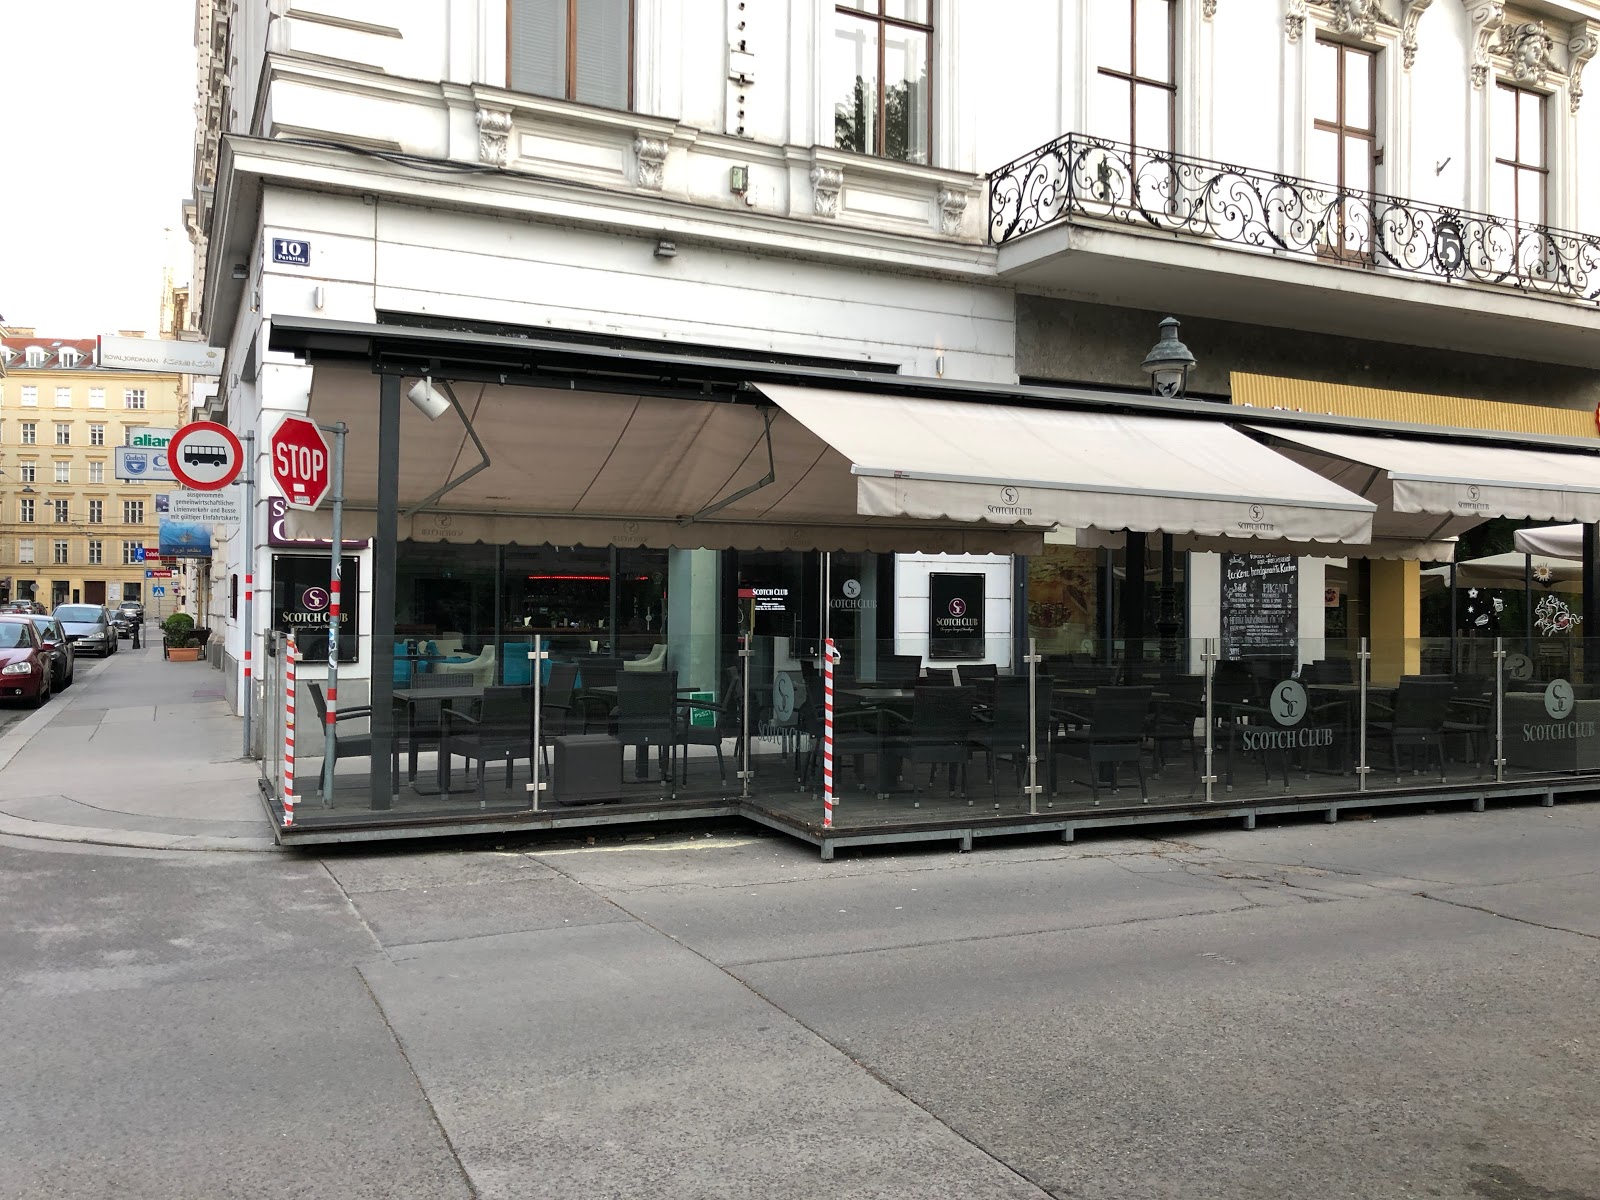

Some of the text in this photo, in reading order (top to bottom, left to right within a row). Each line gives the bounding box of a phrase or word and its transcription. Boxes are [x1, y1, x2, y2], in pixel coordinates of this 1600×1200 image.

[280, 241, 301, 256] 10
[277, 253, 305, 263] Parkring
[122, 356, 159, 364] JORDANIAN
[133, 434, 171, 447] alian
[276, 441, 324, 482] STOP
[175, 499, 235, 507] gemeinwirtschaftlicher
[173, 506, 209, 514] Linienverkehr
[987, 504, 1032, 516] SCOTCH CLUB
[202, 514, 239, 522] Einfahrtskarte
[752, 588, 788, 596] SCOTCH CLUB
[857, 599, 877, 609] CLUB
[282, 611, 322, 623] SCOTCH
[936, 617, 979, 626] SCOTCH CLUB
[1522, 720, 1596, 742] SCOTCH CLUB
[1242, 727, 1333, 751] SCOTCH CLUB
